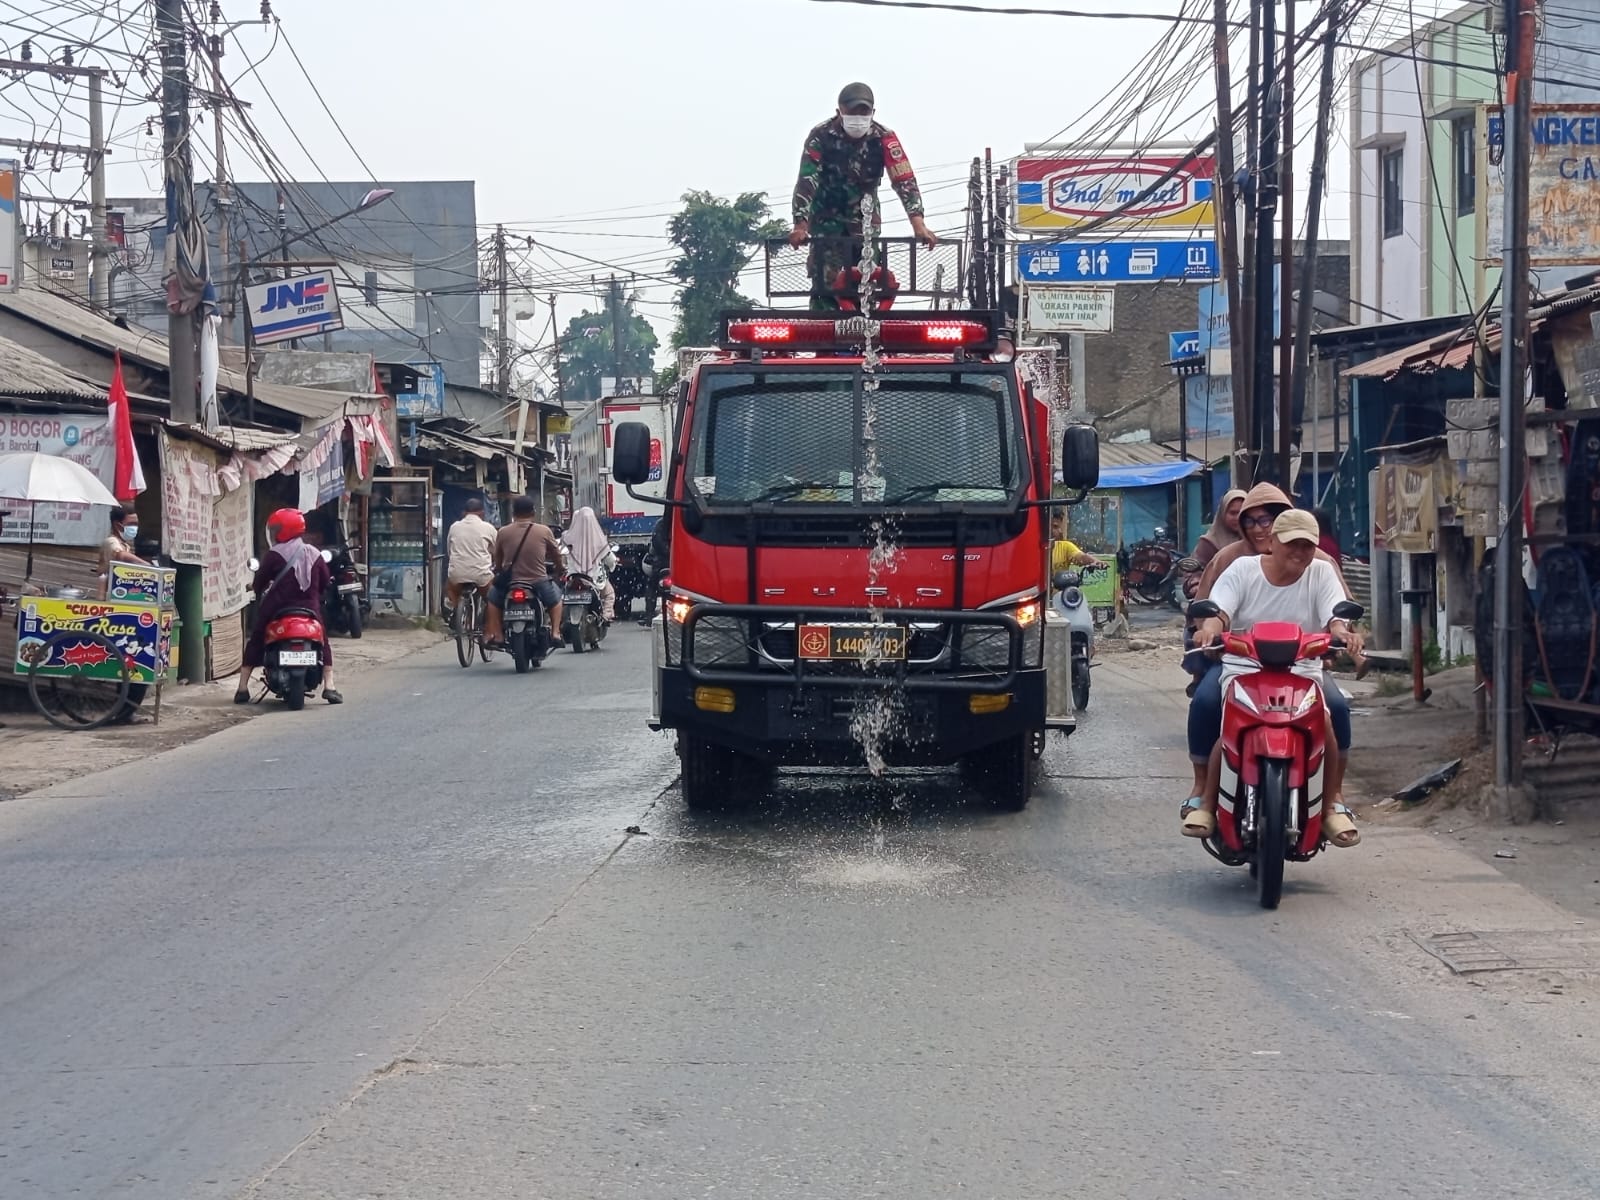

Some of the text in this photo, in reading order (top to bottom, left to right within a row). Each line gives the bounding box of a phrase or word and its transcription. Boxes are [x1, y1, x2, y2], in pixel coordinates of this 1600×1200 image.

[1488, 117, 1600, 145] BNGKE
[259, 277, 329, 313] JNE
[1075, 293, 1106, 301] HUSADA
[1040, 302, 1103, 311] LOKASI PARKIR
[1045, 312, 1074, 320] RAWAT
[10, 420, 60, 438] BOGOR
[764, 587, 942, 597] FUSO
[40, 614, 85, 634] Setia
[88, 618, 137, 637] Rasa
